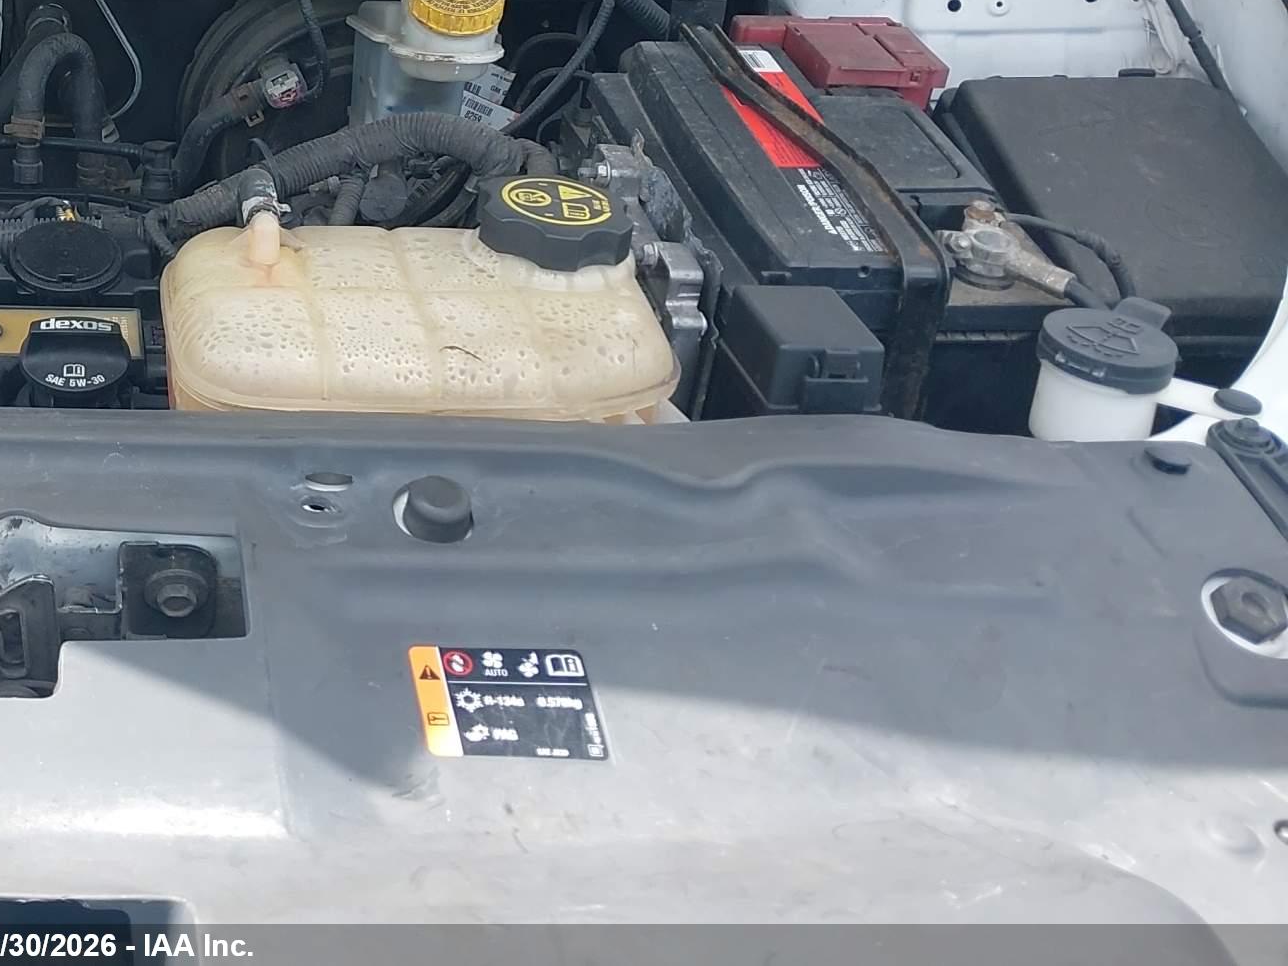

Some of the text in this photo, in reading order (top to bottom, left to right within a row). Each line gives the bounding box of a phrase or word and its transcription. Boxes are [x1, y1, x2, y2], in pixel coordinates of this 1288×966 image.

[39, 318, 114, 332] dexos
[45, 374, 106, 388] SAE 5W-30
[485, 668, 509, 677] AUTO
